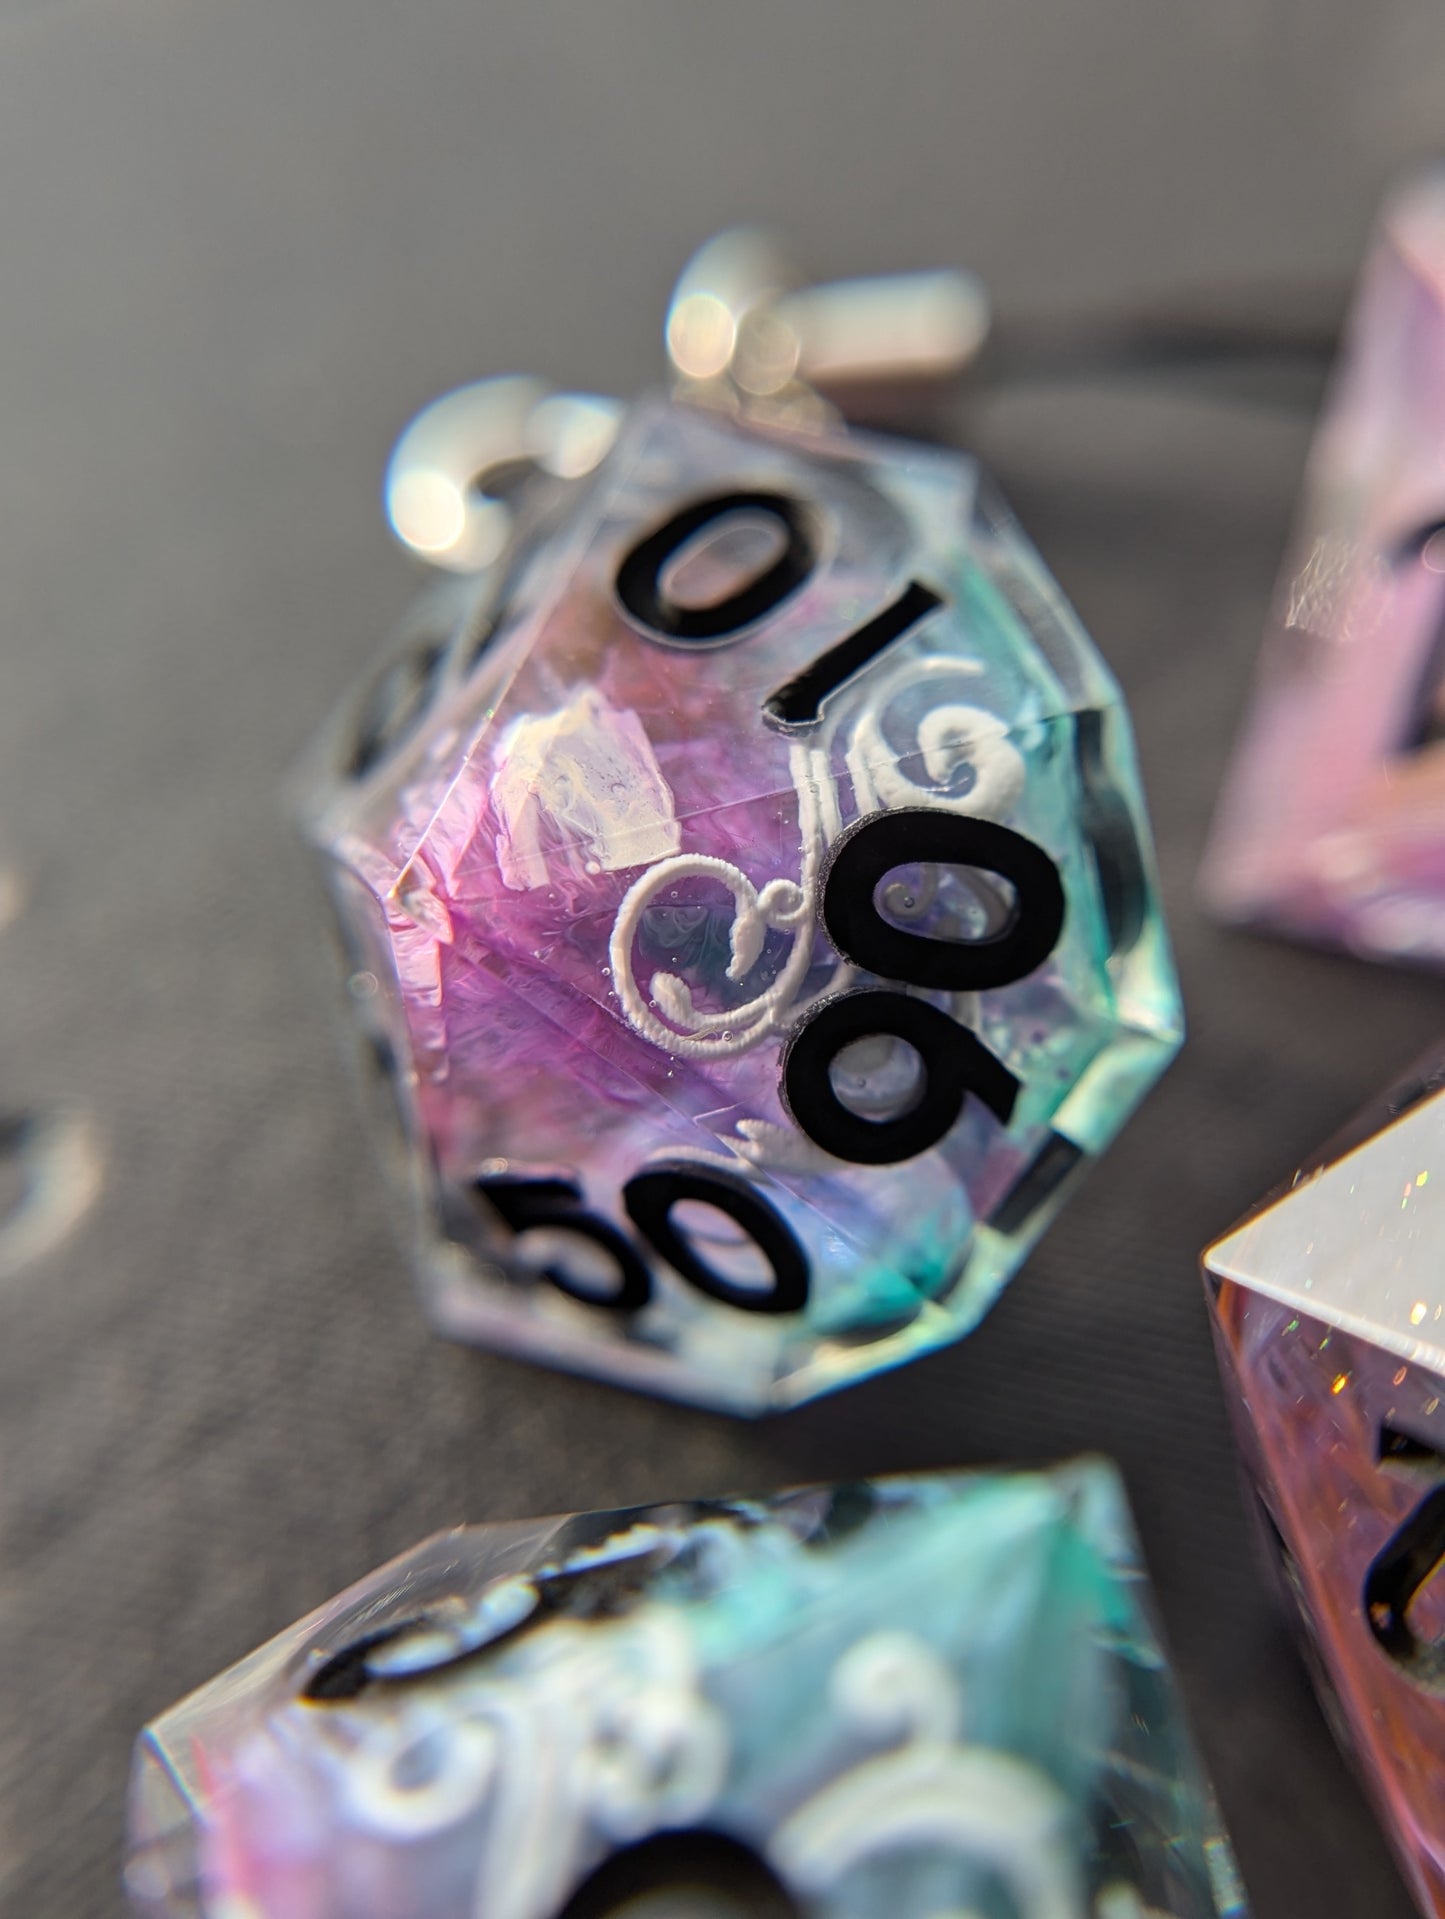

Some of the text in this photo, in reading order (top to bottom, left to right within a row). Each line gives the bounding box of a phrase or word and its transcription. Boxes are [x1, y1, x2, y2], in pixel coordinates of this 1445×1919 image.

[614, 489, 944, 736] 10
[779, 806, 1066, 1166] 90
[472, 1162, 812, 1314] 50
